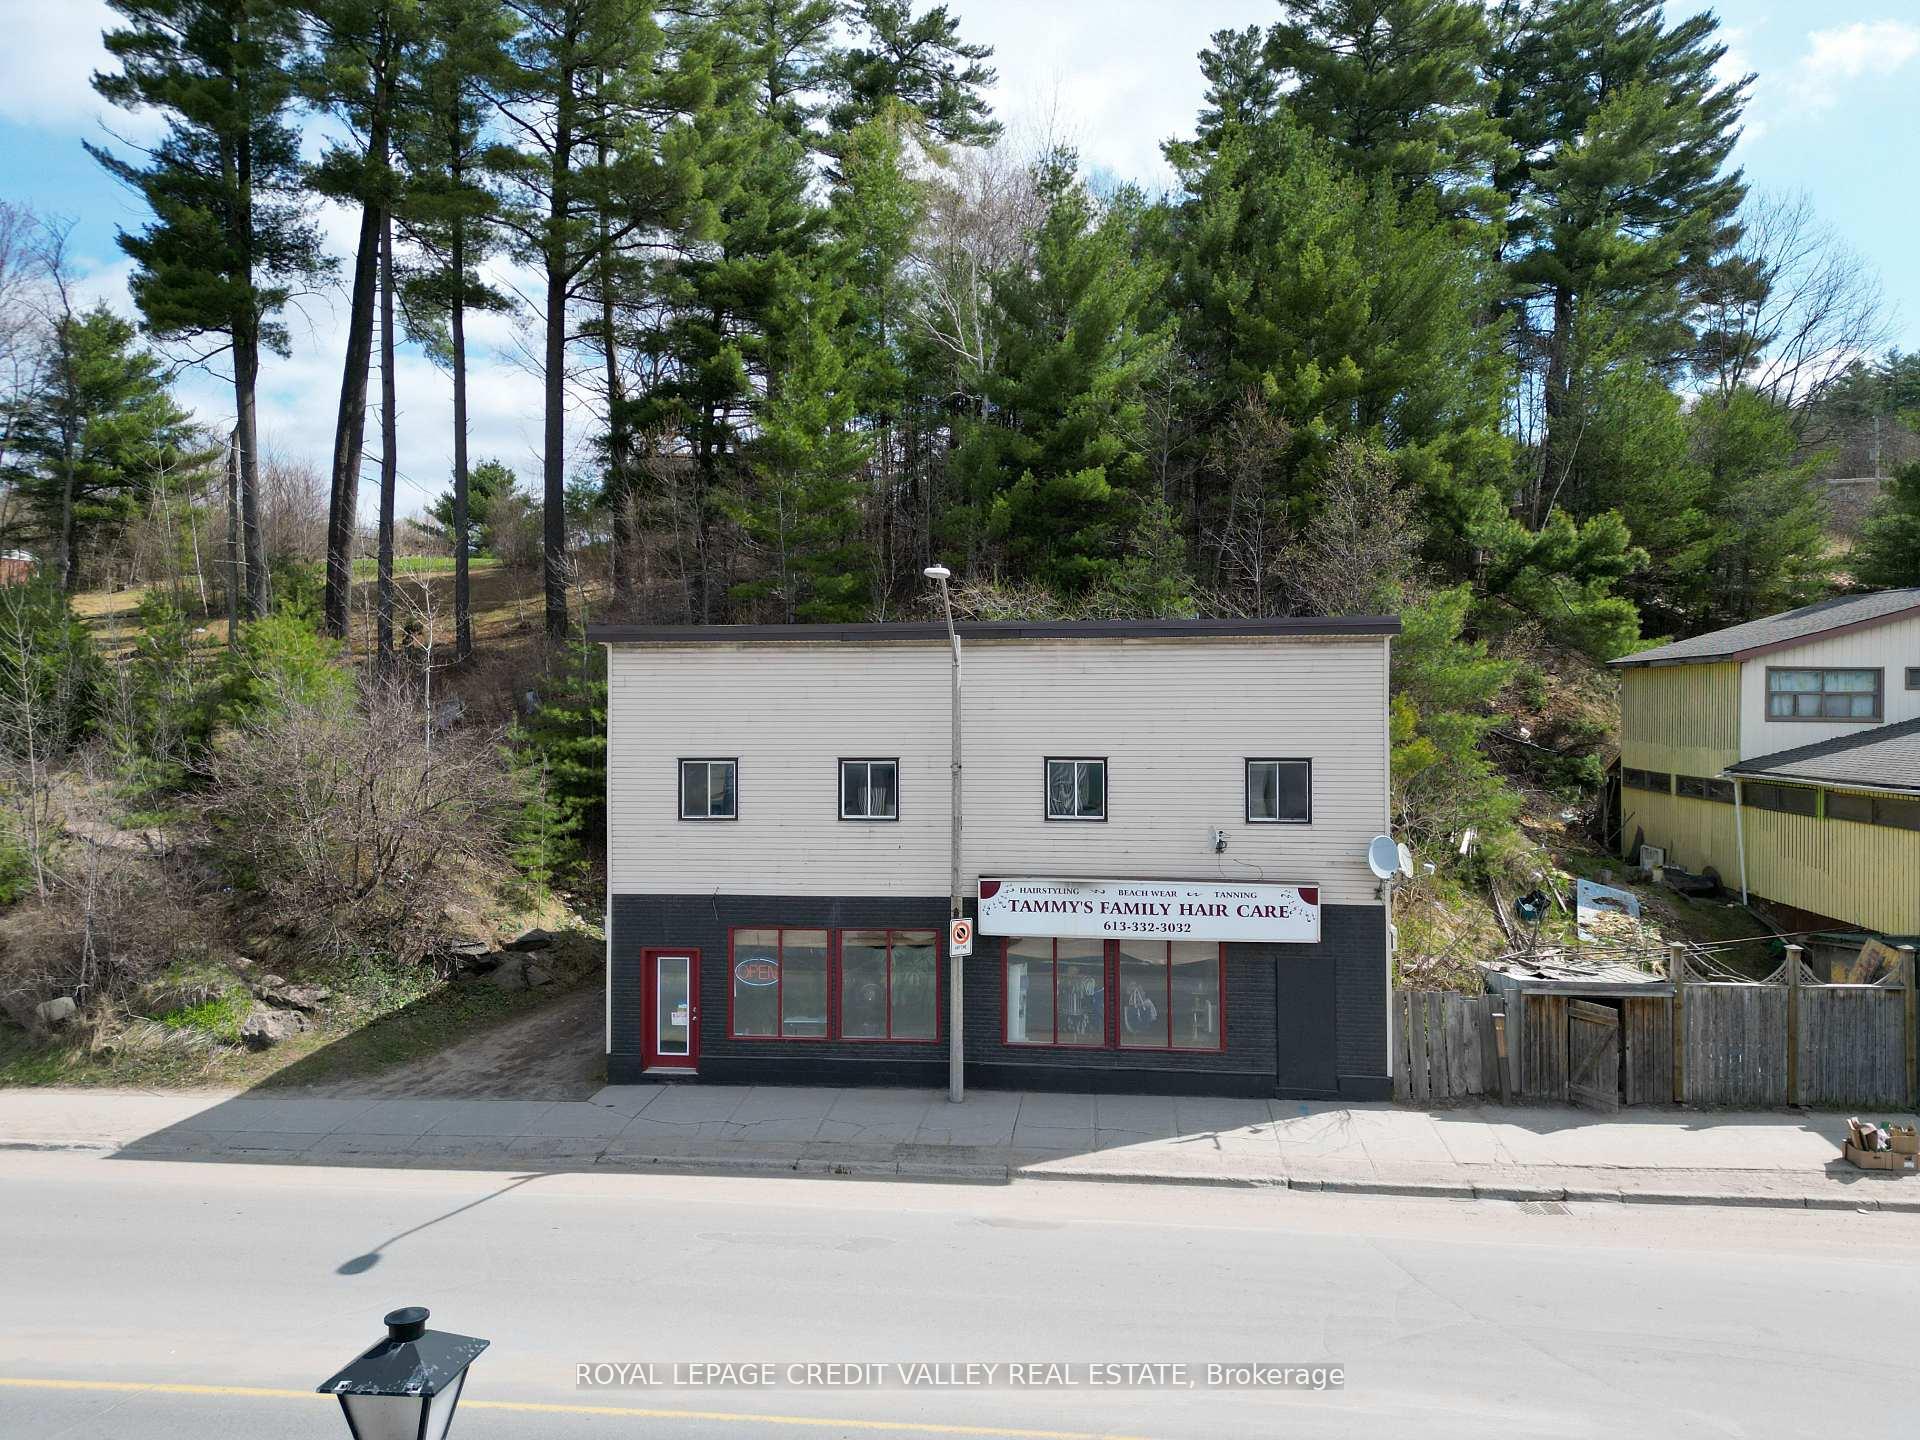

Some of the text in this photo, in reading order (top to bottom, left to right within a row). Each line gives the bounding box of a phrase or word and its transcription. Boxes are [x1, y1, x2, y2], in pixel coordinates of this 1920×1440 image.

[1019, 887, 1080, 895] HAIRSTYLING
[1118, 889, 1148, 897] BEACH
[1214, 891, 1258, 899] TANNING
[1008, 899, 1290, 918] TAMMY'S FAMILY HAIR CARE
[1103, 921, 1191, 933] 613-332-3032
[738, 964, 779, 980] OPEN
